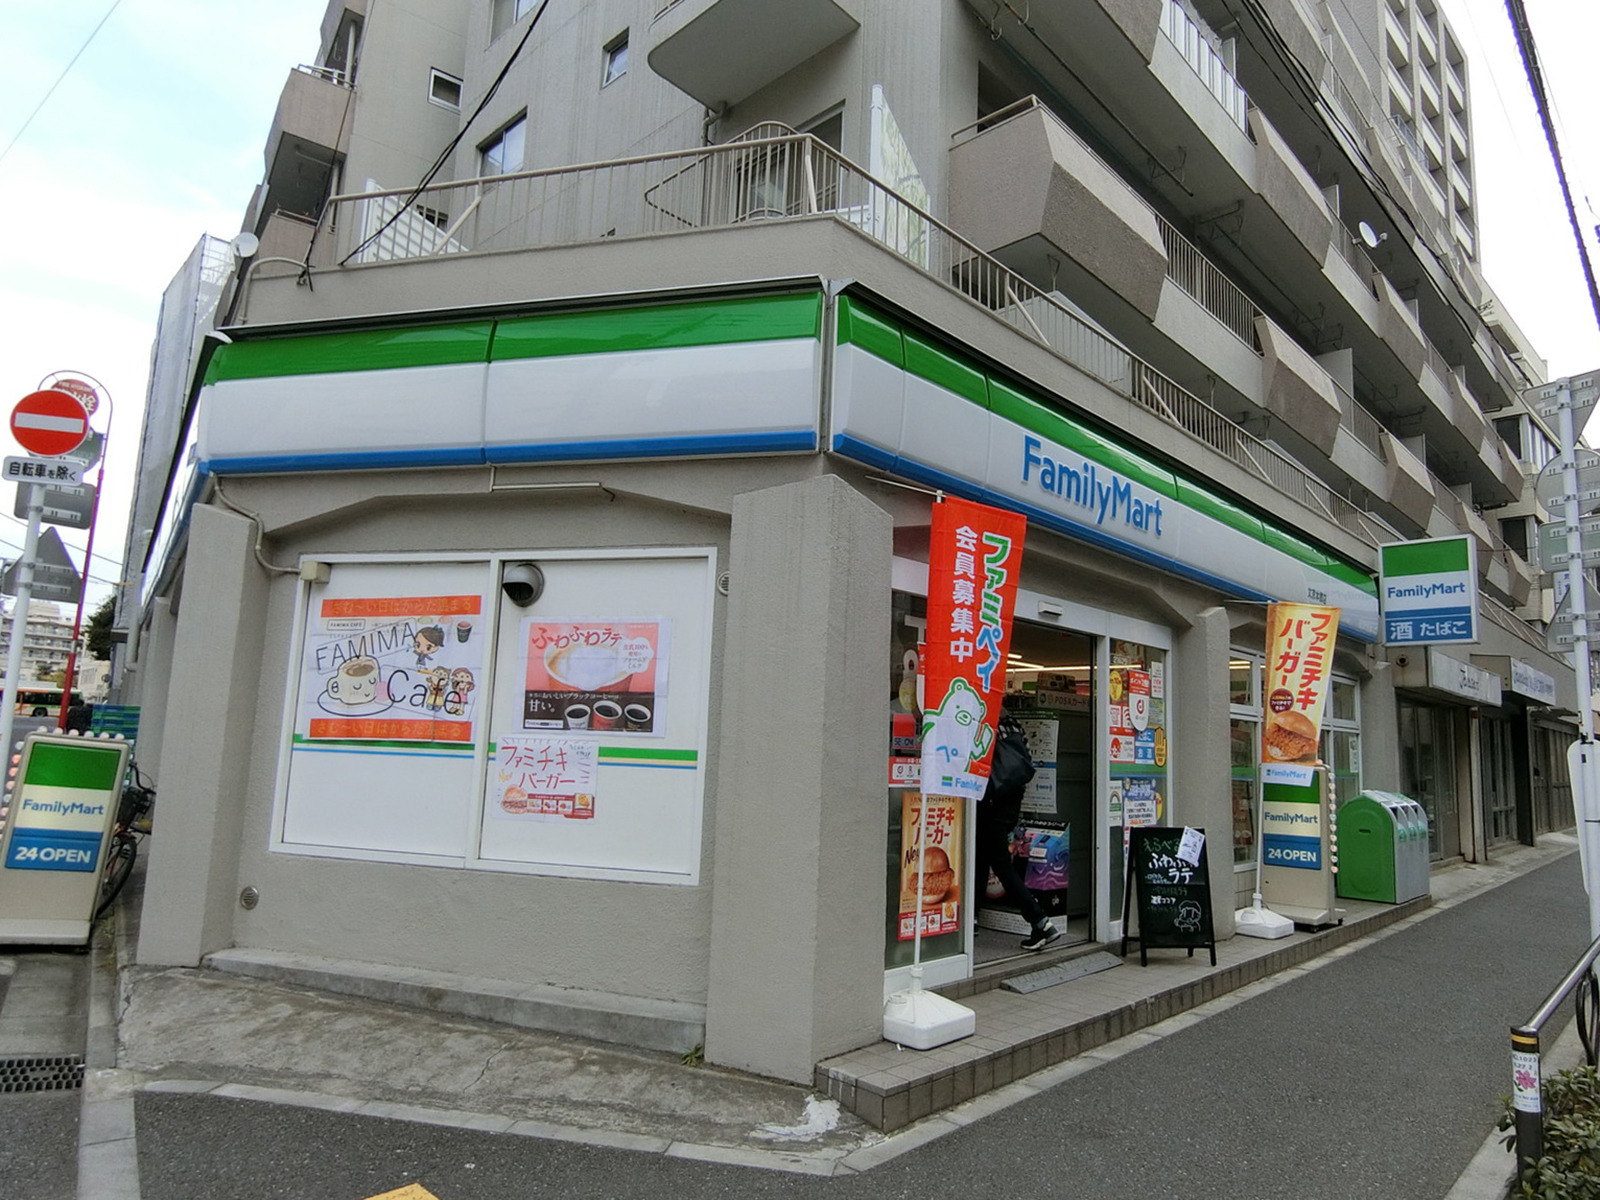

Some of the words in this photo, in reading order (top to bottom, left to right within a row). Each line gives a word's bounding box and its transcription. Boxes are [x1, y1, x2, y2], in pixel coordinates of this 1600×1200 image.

[8, 461, 77, 482] 自転車を除く
[1022, 434, 1163, 537] FamilyMart
[950, 525, 978, 663] 会員募集中
[1387, 582, 1466, 599] FamilyMart
[976, 531, 1012, 692] ファミペイ
[532, 626, 622, 650] ふわふわラテ
[1390, 621, 1413, 640] 酒
[1419, 620, 1467, 637] たばこ
[316, 622, 417, 671] FAMIMA
[1275, 618, 1311, 687] バーガー
[1296, 613, 1332, 711] ファミチキ
[387, 669, 462, 715] Cafe
[501, 745, 568, 771] ファミチキ
[519, 772, 576, 789] バーガー
[22, 799, 104, 816] FamilyMart
[911, 807, 955, 826] フミチキ
[1264, 812, 1319, 825] FamilyMart
[1168, 867, 1194, 884] ラテ
